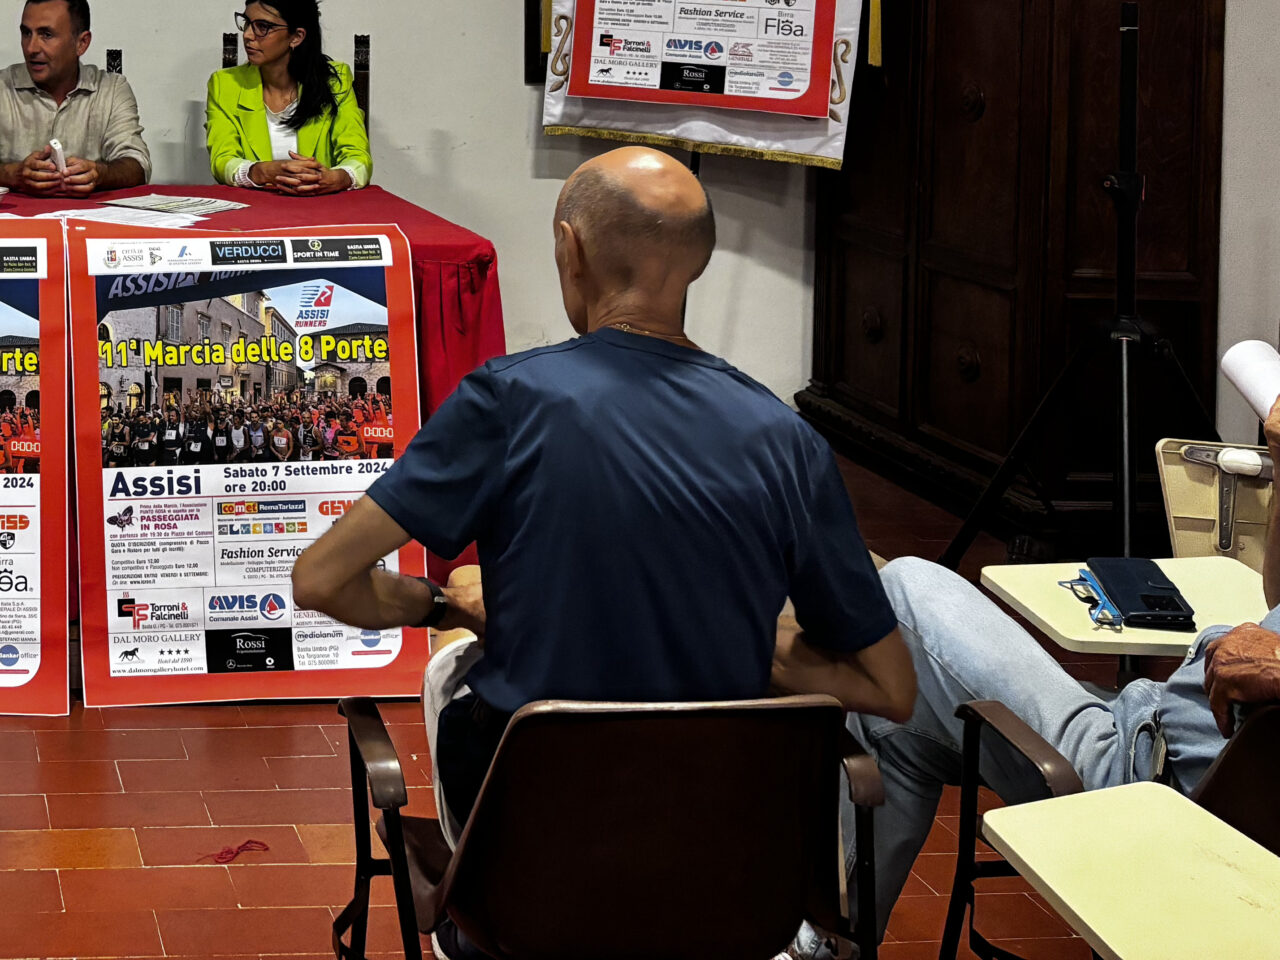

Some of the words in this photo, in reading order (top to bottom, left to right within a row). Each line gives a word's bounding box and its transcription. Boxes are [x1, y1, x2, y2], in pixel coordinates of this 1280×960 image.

[679, 7, 712, 16] Fashion
[714, 9, 745, 19] Service
[666, 38, 703, 51] AVIS
[216, 245, 281, 258] VERDUCCI
[142, 337, 226, 367] Marcia
[231, 335, 293, 364] delle
[298, 336, 314, 361] 8
[321, 334, 388, 361] Porte
[224, 466, 268, 478] Sabato
[272, 466, 280, 477] 7
[284, 463, 352, 476] Settembre
[358, 462, 390, 474] 2024
[3, 477, 34, 488] 2024
[108, 469, 202, 497] Assisi
[224, 484, 245, 493] ore
[251, 481, 286, 492] 20:00
[220, 547, 264, 559] Fashion
[150, 603, 180, 612] Torroni
[208, 595, 258, 610] AVIS
[150, 611, 188, 621] Falcinelli
[133, 635, 159, 643] MORO
[161, 634, 201, 642] GALLERY
[236, 637, 265, 649] Rossi
